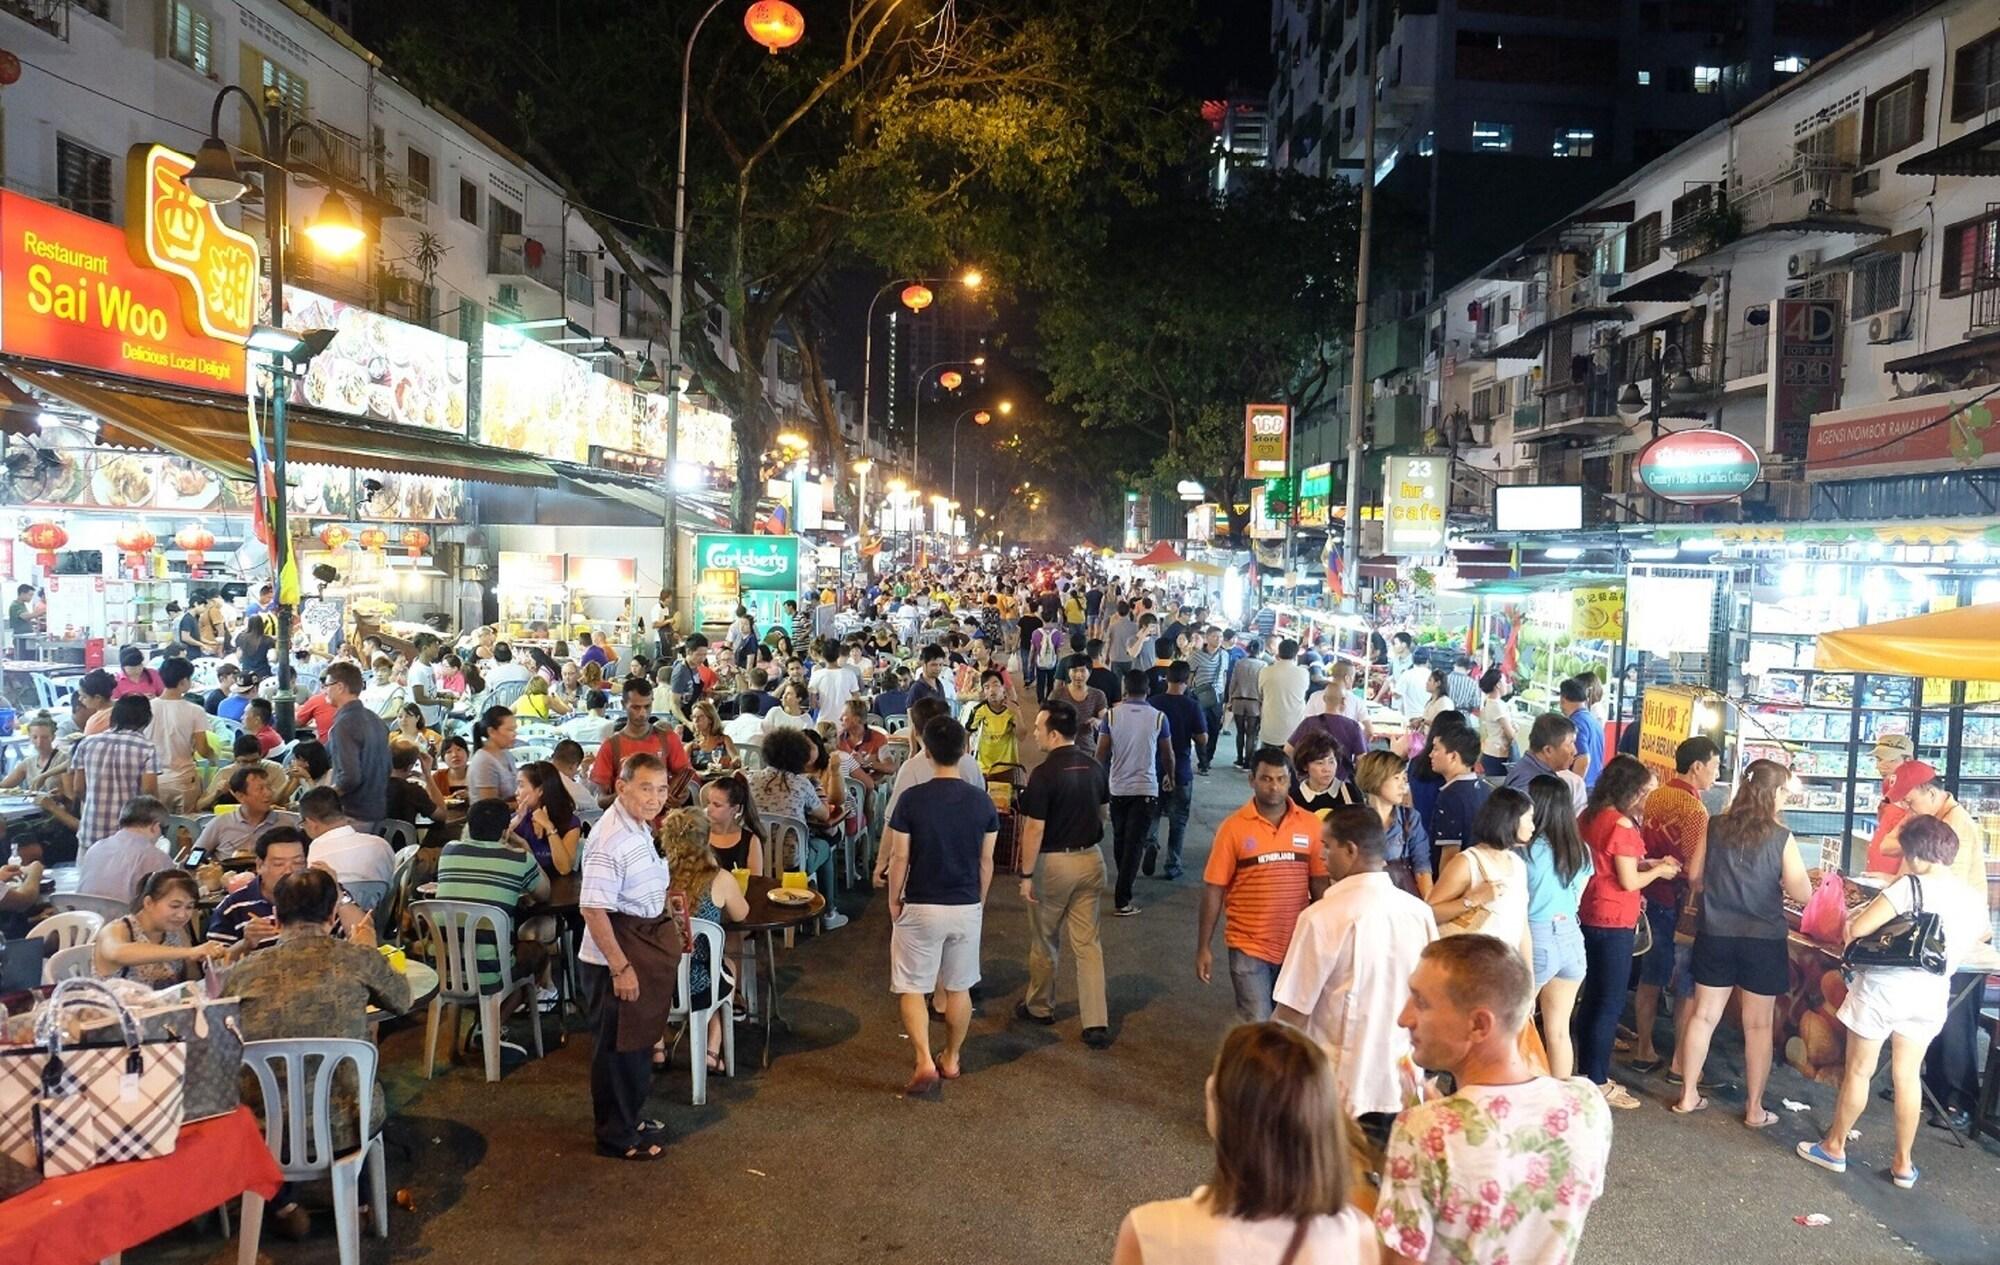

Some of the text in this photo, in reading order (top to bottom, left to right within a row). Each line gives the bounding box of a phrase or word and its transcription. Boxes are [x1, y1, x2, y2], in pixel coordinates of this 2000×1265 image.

[24, 230, 108, 275] Restaurant
[28, 263, 167, 341] Sai Woo
[1784, 304, 1834, 341] 4D
[122, 342, 231, 381] Delicious Local Delight
[1252, 415, 1284, 434] 168
[1816, 430, 1847, 445] AGENSI
[1849, 421, 1887, 443] NOMBOR
[1407, 460, 1432, 478] 23
[1401, 481, 1435, 499] hrs
[1392, 503, 1441, 521] cafe
[706, 542, 789, 575] Carlsberg
[1257, 852, 1295, 863] NETHERLANDS
